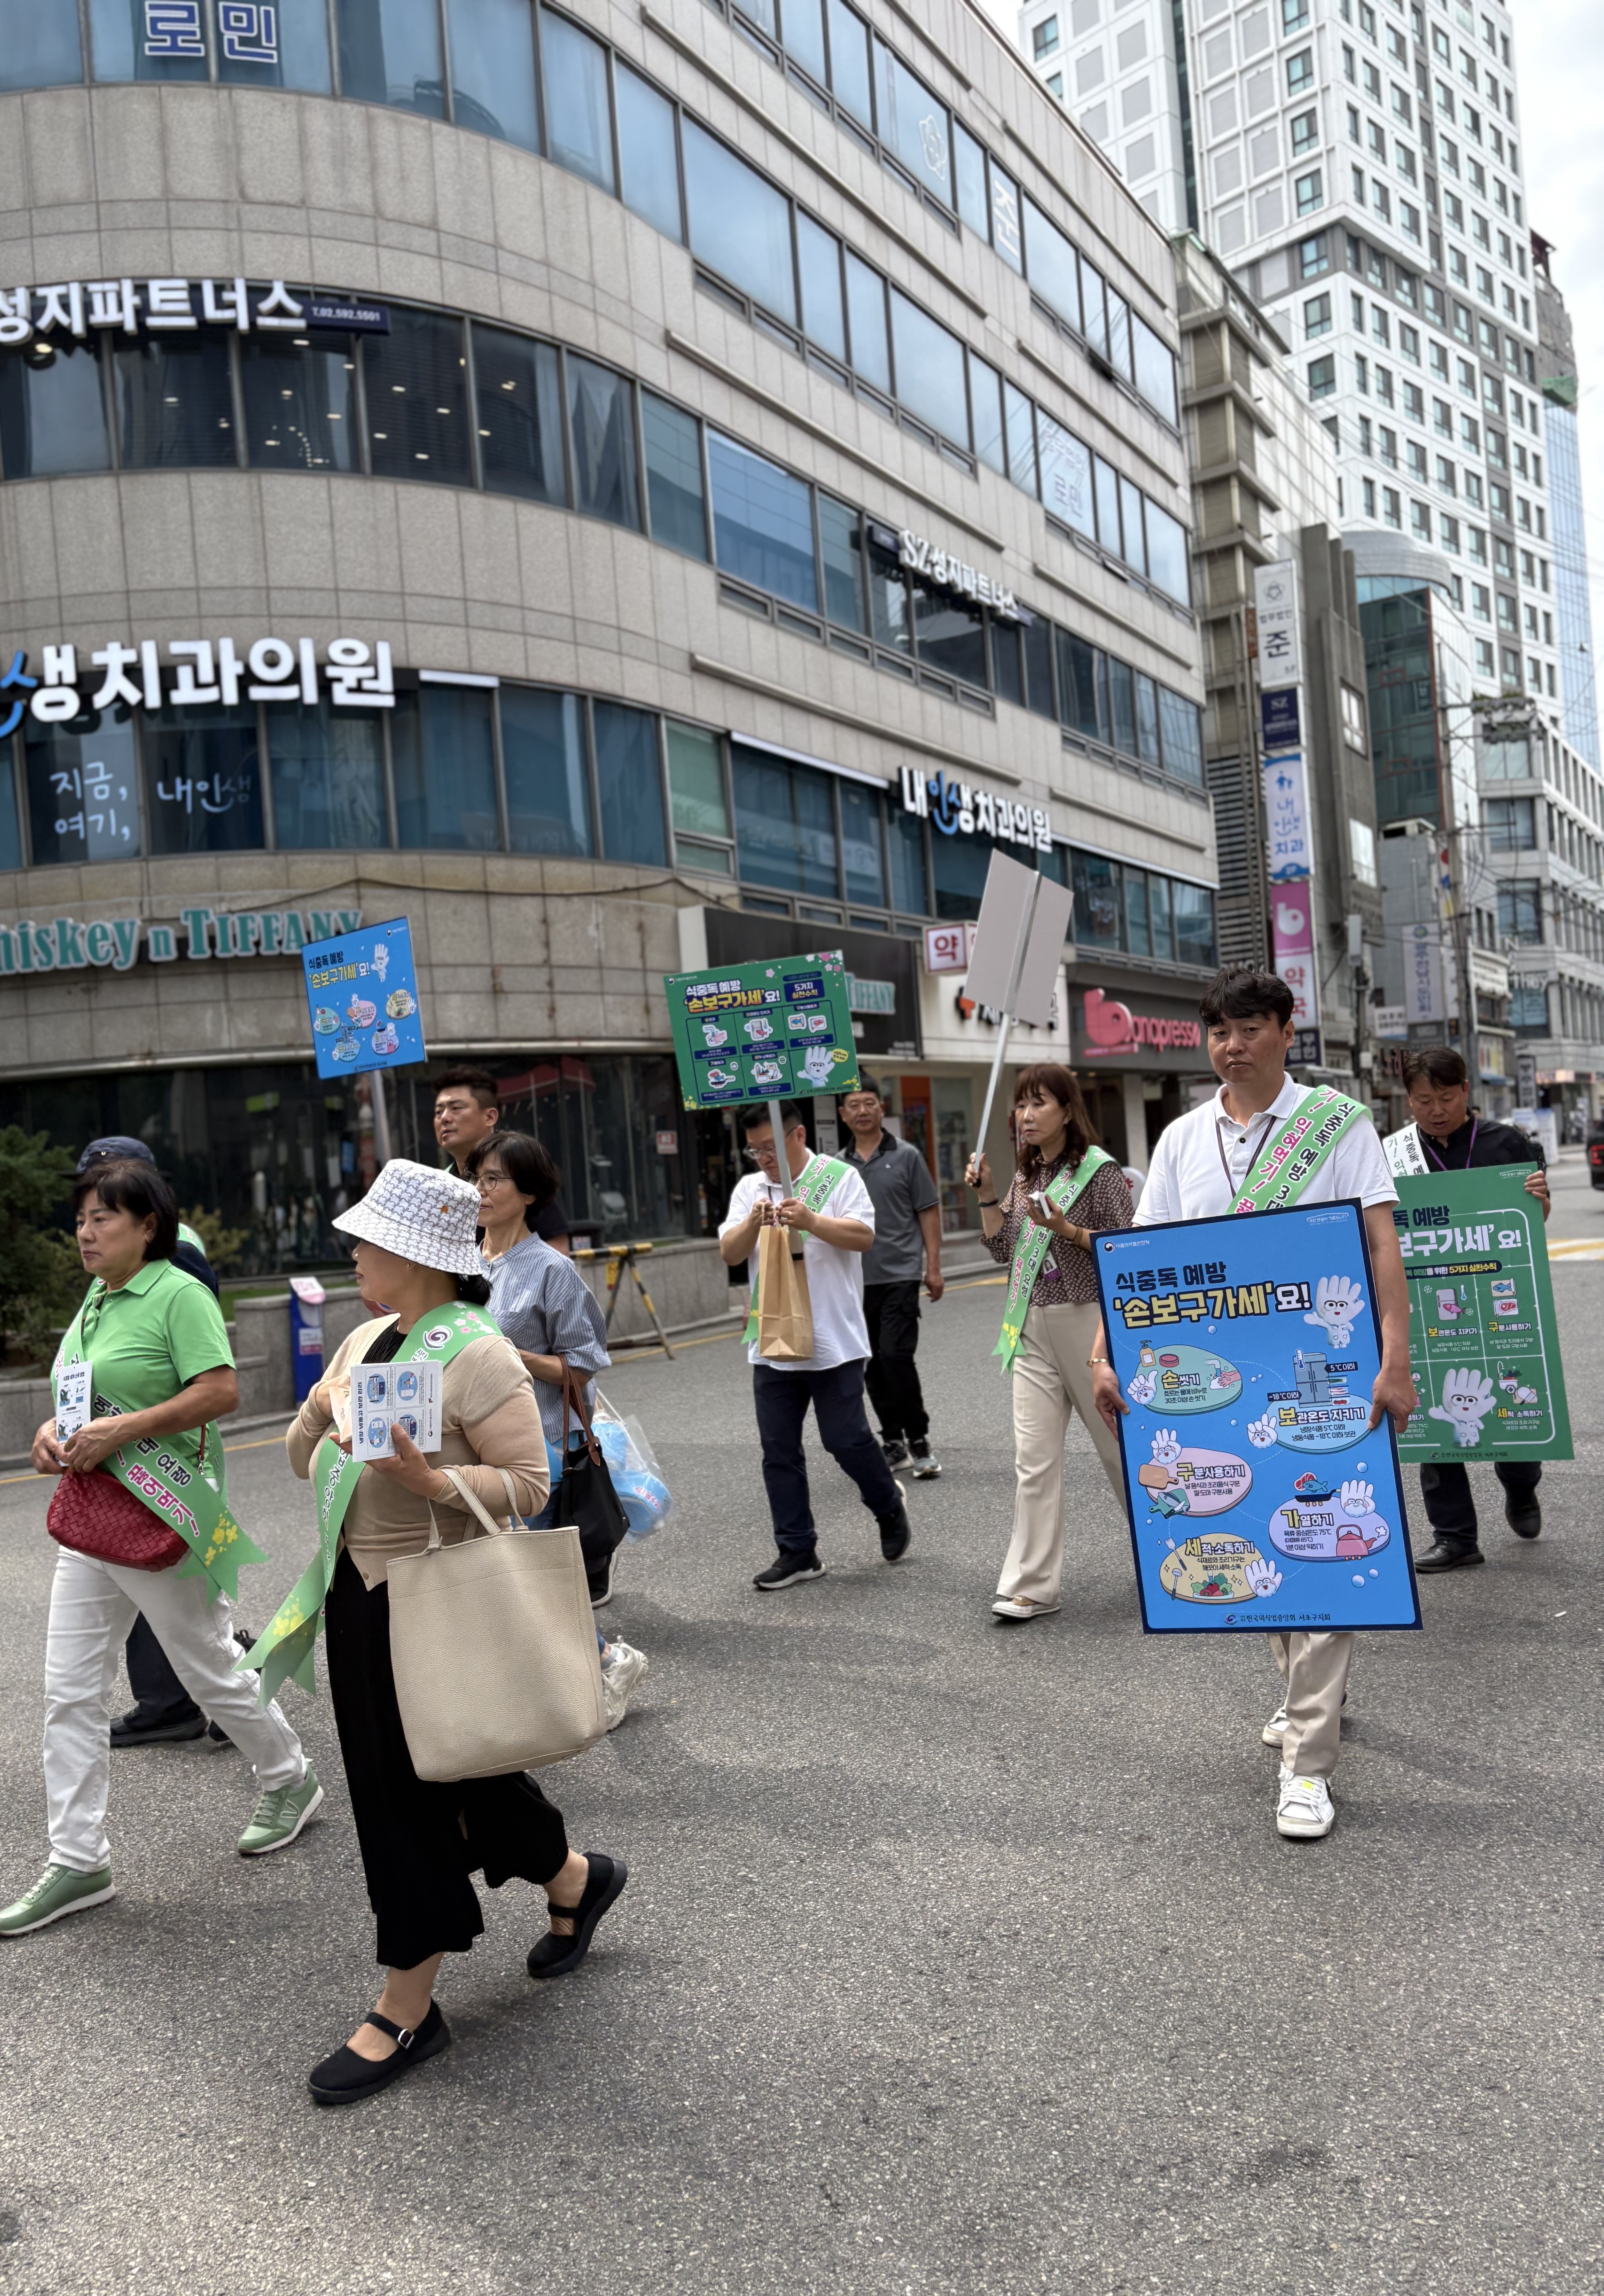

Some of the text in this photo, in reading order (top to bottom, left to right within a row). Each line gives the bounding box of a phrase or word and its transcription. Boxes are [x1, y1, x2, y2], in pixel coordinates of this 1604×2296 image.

[145, 1, 278, 63] 로민
[930, 546, 1019, 620] 성지파트너스
[1264, 630, 1291, 658] 준
[0, 637, 396, 737] 생치과의원
[50, 761, 128, 801] 지금,
[157, 773, 252, 814] 내인생
[54, 809, 131, 840] 여기,
[901, 765, 1053, 854] 내인생치과의원
[147, 926, 177, 963] n
[308, 950, 344, 969] 식중독 예방
[934, 934, 959, 961] 약
[686, 980, 742, 997] 식중독 예방
[794, 982, 814, 992] 5가지
[1313, 1101, 1357, 1147] 식중독
[1251, 1117, 1313, 1193] 익혀먹기!
[1403, 1132, 1419, 1163] 식중독
[1287, 1148, 1321, 1182] 예방
[1413, 1164, 1425, 1175] 예
[812, 1174, 835, 1206] 식중독
[1413, 1205, 1450, 1227] 예방
[1115, 1261, 1227, 1293] 식중독 예방
[1449, 1265, 1468, 1274] 5가지
[1458, 1327, 1477, 1335] 지키기
[1162, 1370, 1201, 1389] 손씻기
[1279, 1407, 1366, 1427] 보관온도 지키기
[157, 1454, 192, 1487] 요령
[1176, 1462, 1246, 1481] 구분사용하기
[126, 1463, 200, 1537] 끓어먹기!
[1281, 1508, 1334, 1529] 가열하기
